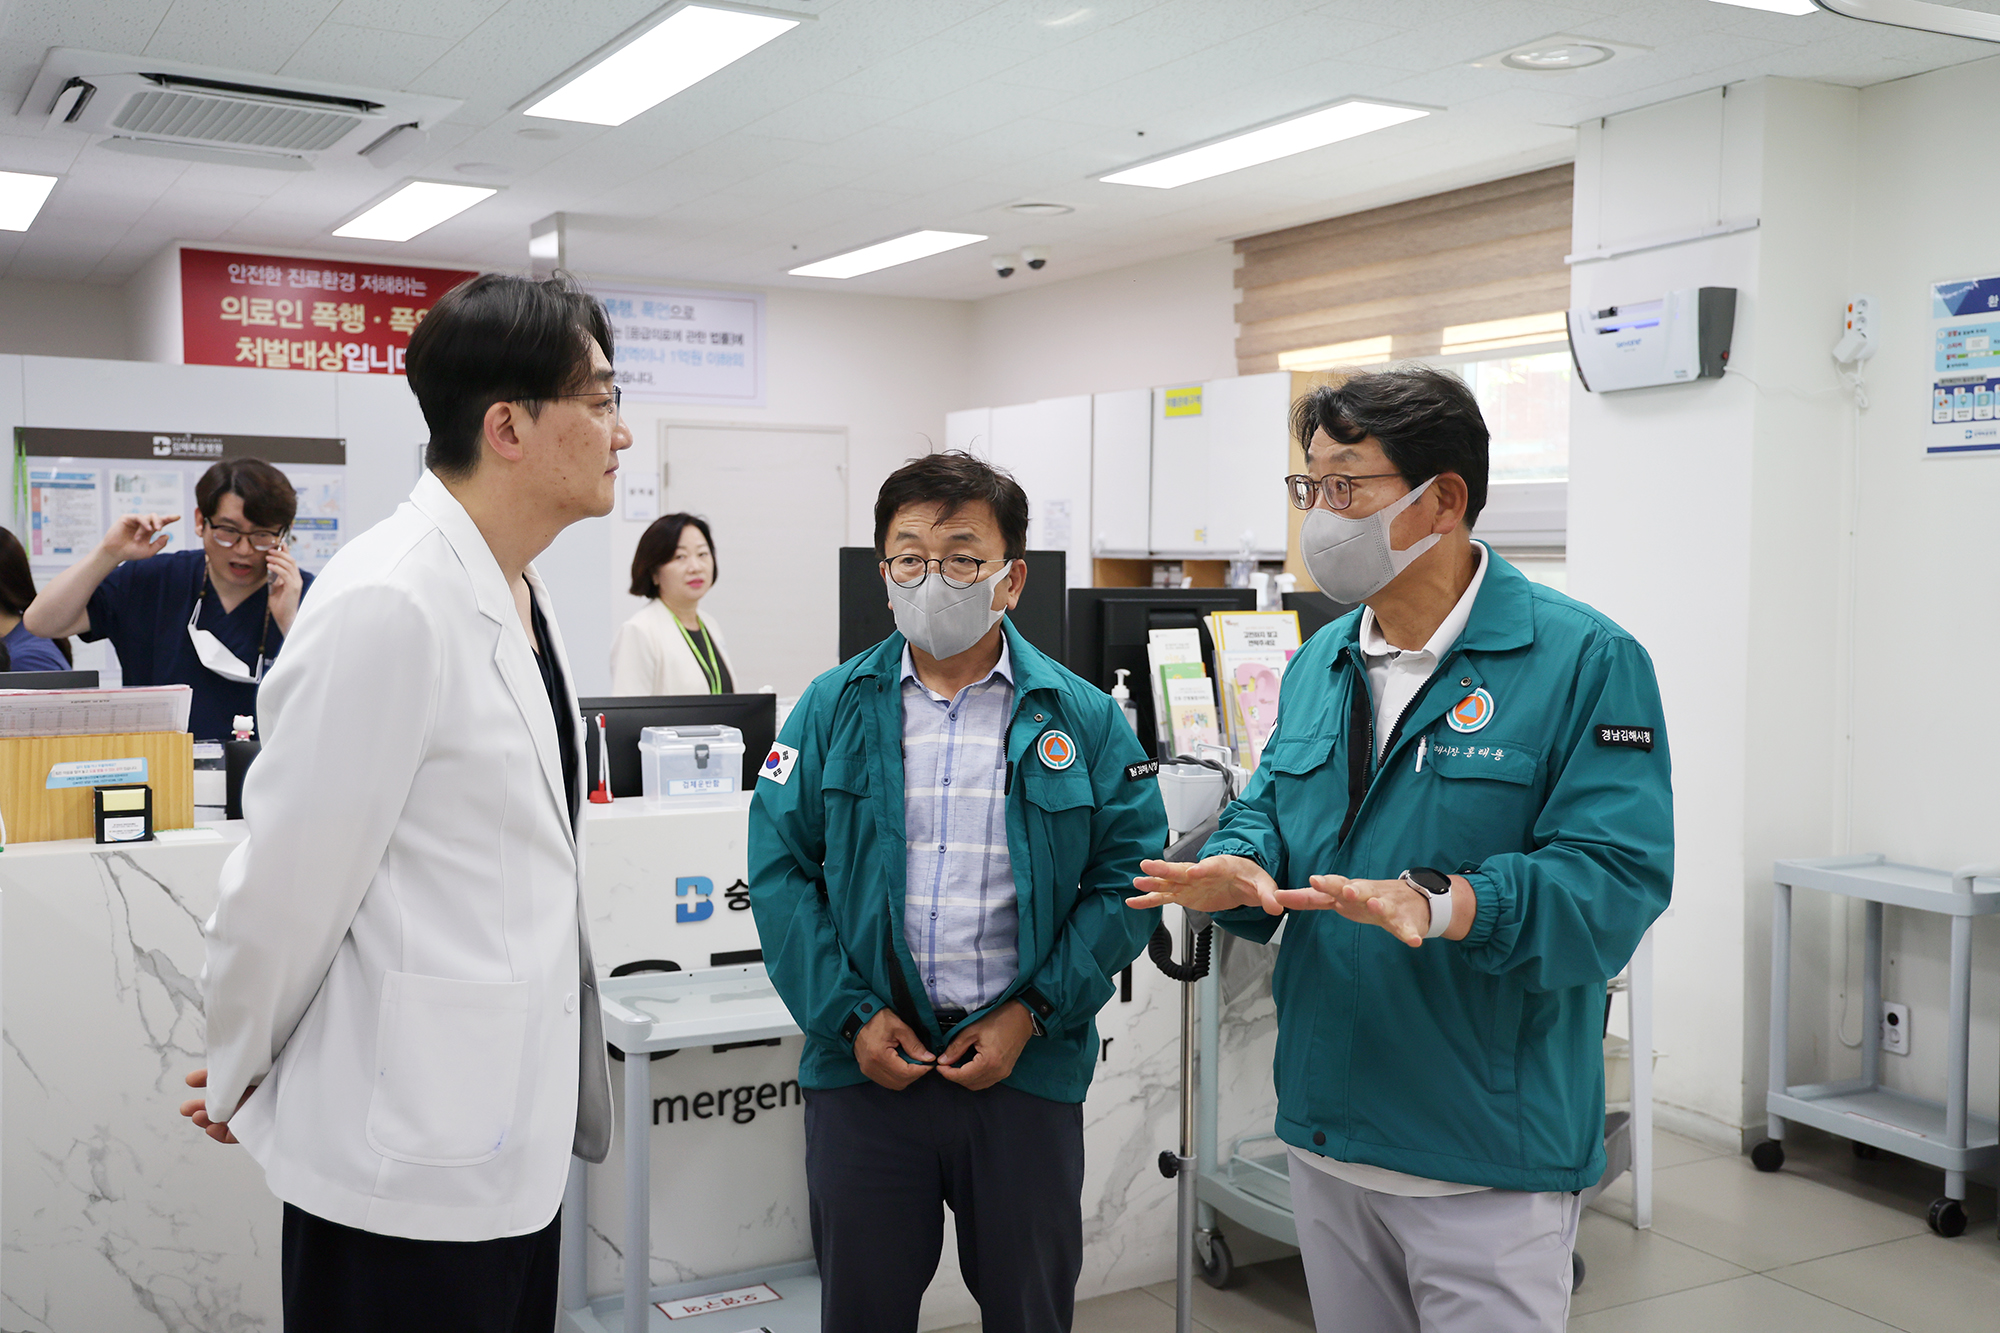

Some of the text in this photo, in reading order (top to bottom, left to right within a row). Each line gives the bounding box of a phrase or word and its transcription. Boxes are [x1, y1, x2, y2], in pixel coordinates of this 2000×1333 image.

[228, 263, 427, 297] 안전한 진료환경 저해하는
[220, 296, 303, 329] 의료인
[311, 301, 365, 334] 폭행
[1601, 729, 1651, 743] 경남김해시청
